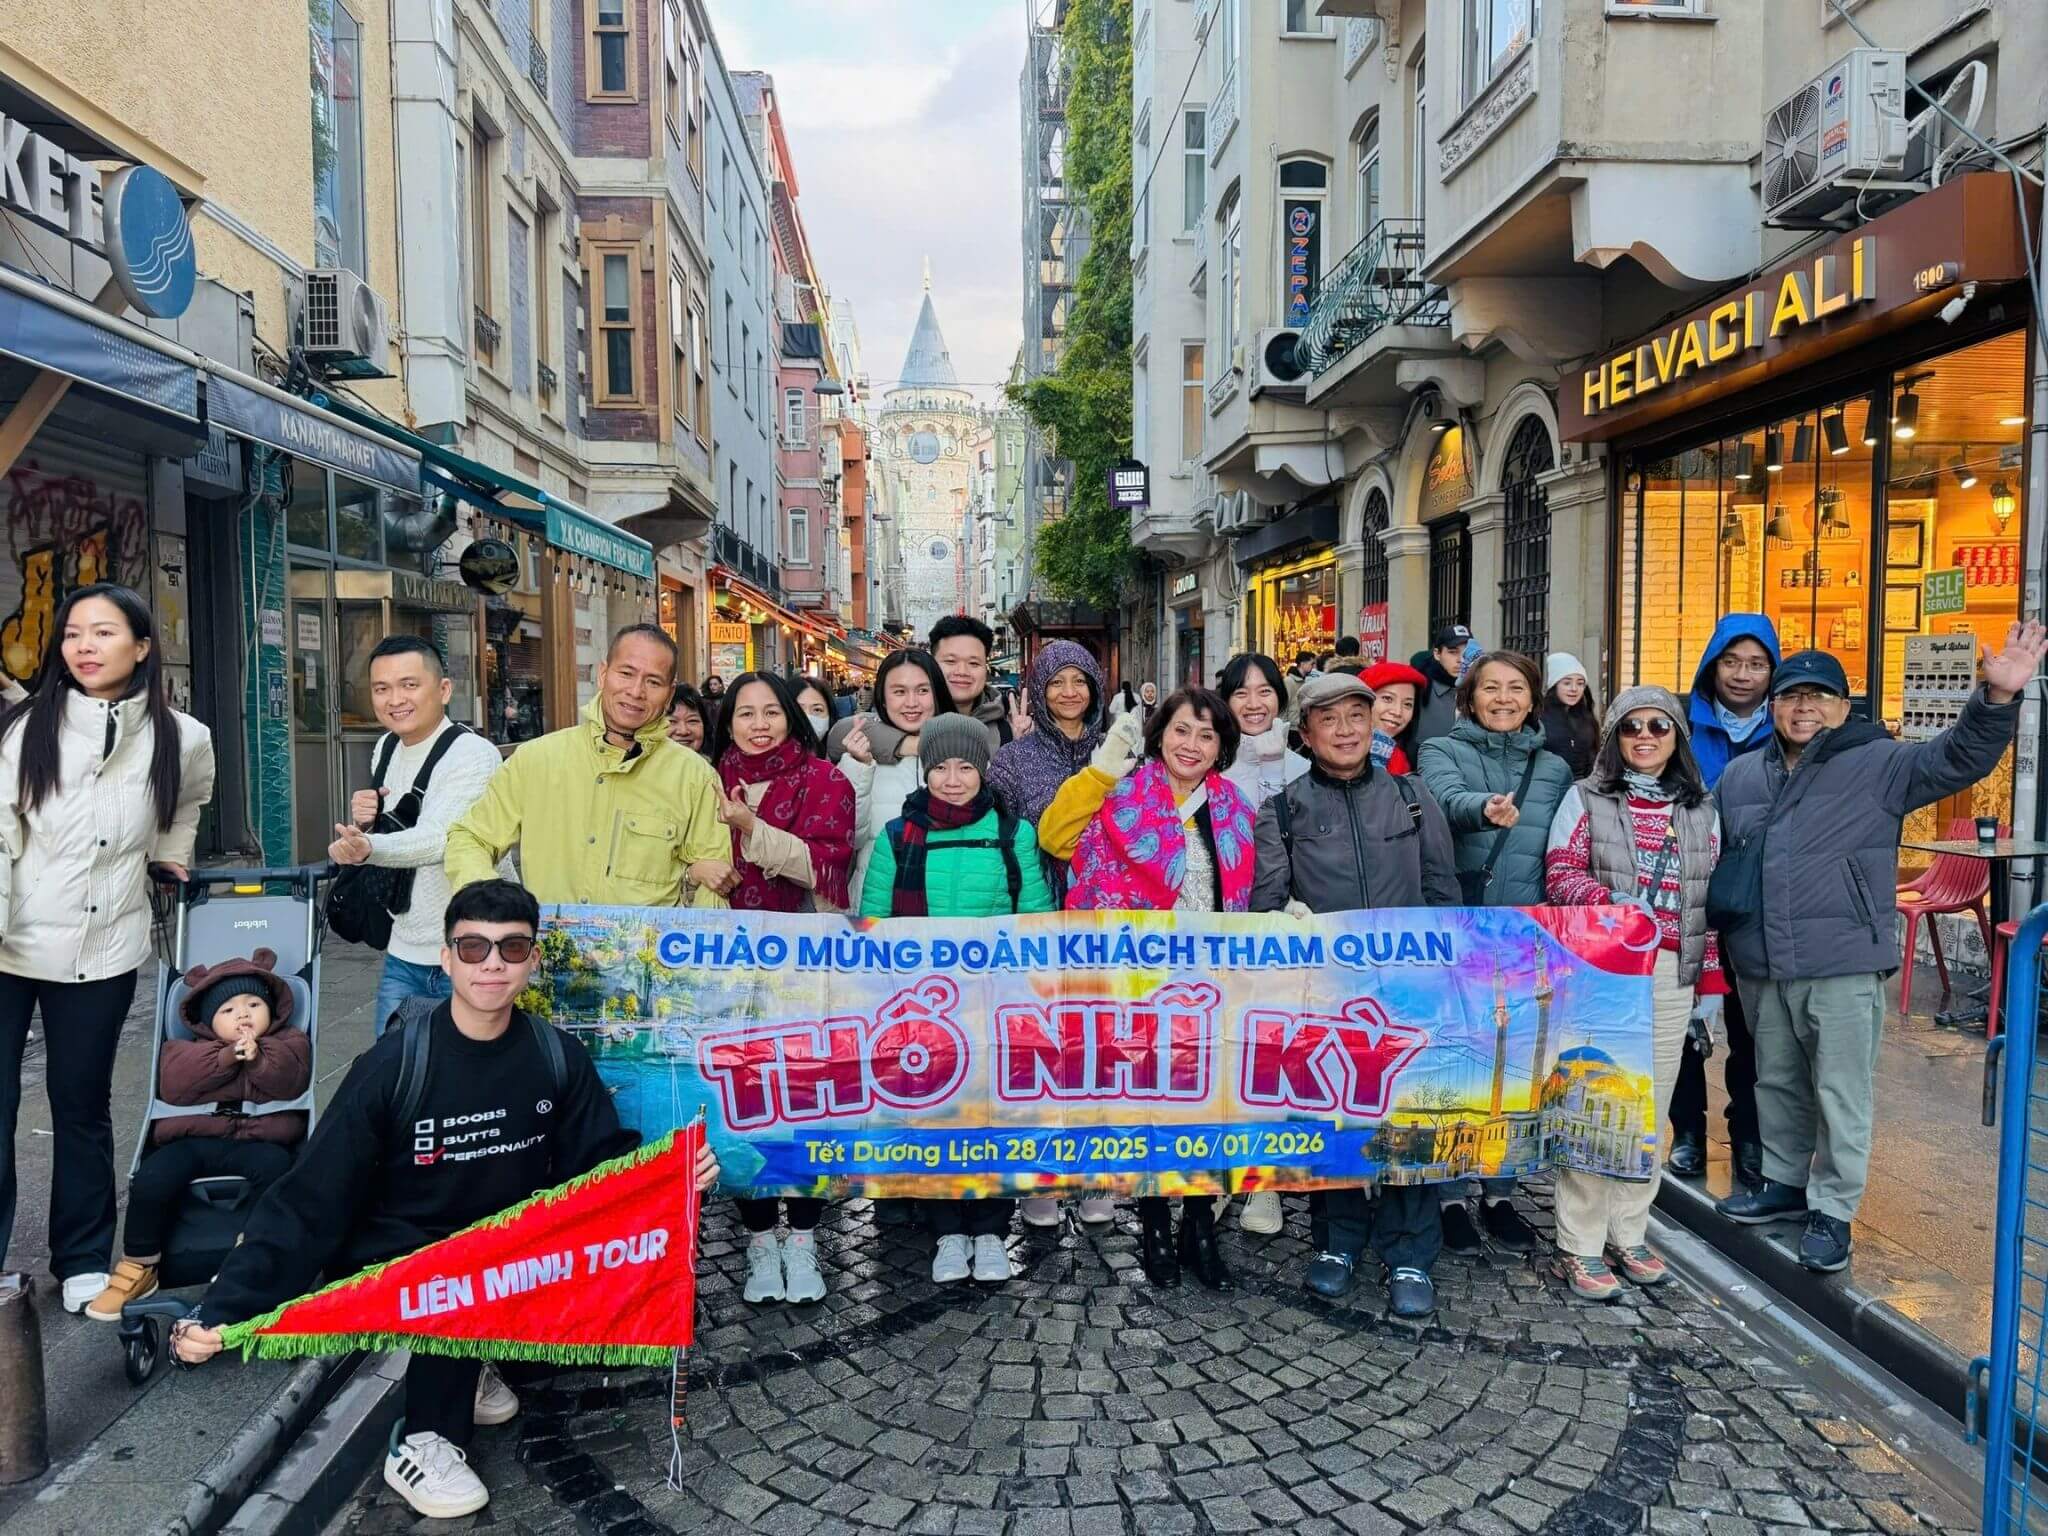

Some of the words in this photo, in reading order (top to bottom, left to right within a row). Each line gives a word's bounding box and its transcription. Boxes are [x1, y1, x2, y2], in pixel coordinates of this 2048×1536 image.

[1583, 290, 1764, 416] HELVACI
[279, 410, 331, 453] KANAAT
[333, 434, 376, 470] MARKET
[1926, 574, 1963, 598] SELF
[1926, 597, 1963, 612] SERVICE
[714, 626, 742, 640] TANTO
[660, 925, 788, 965] CHÀO
[800, 929, 922, 969] MỪNG
[931, 930, 1049, 969] ĐOÀN
[1058, 925, 1195, 966] KHÁCH
[1203, 935, 1325, 966] THAM
[1333, 931, 1453, 966] QUAN
[702, 976, 970, 1130] THỔ
[997, 983, 1220, 1101] NHĨ
[1243, 998, 1427, 1116] KỲ
[443, 1108, 506, 1128] BOOBS
[443, 1128, 500, 1145] BUTTS
[443, 1134, 546, 1161] PERSONALITY
[806, 1138, 845, 1163] Tết
[854, 1141, 941, 1167] Dương
[949, 1139, 998, 1167] Lịch
[1005, 1136, 1148, 1164] 28/12/2025
[1175, 1131, 1325, 1159] 06/01/2026
[400, 1274, 474, 1320] LIÊN
[483, 1250, 573, 1301] MINH
[584, 1228, 669, 1275] TOUR
